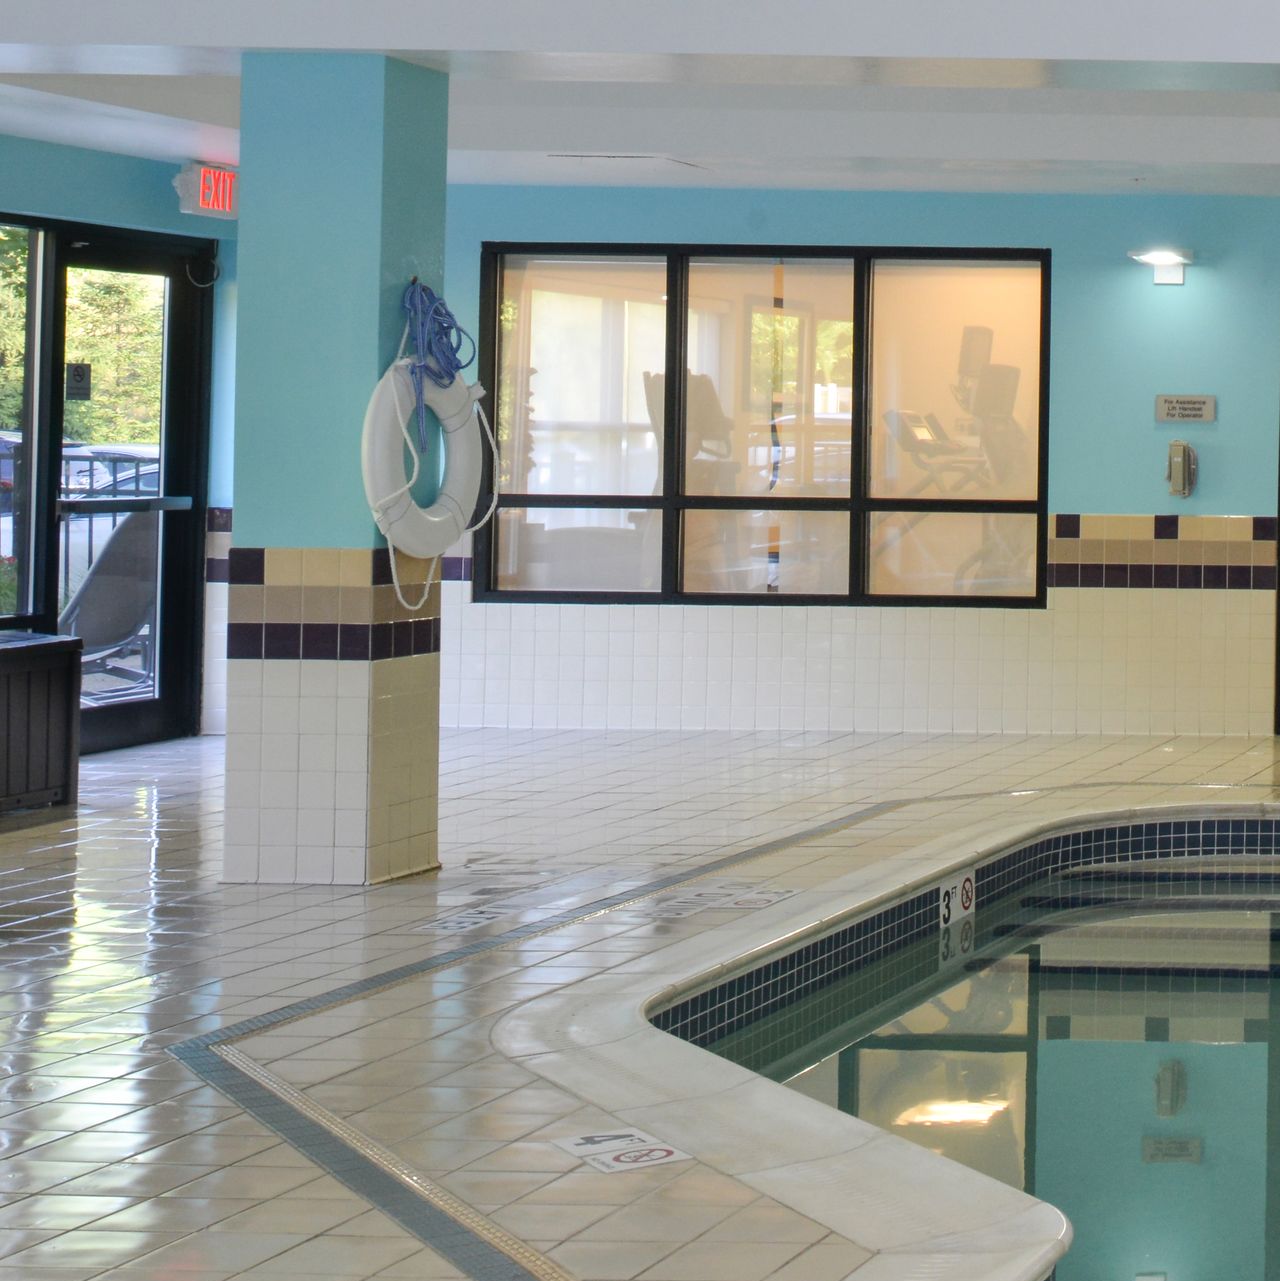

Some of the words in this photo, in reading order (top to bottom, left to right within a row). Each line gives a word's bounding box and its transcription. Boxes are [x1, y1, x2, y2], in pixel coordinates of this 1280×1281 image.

[199, 167, 236, 213] EXIT
[942, 888, 951, 925] 3
[573, 1133, 636, 1147] 4
